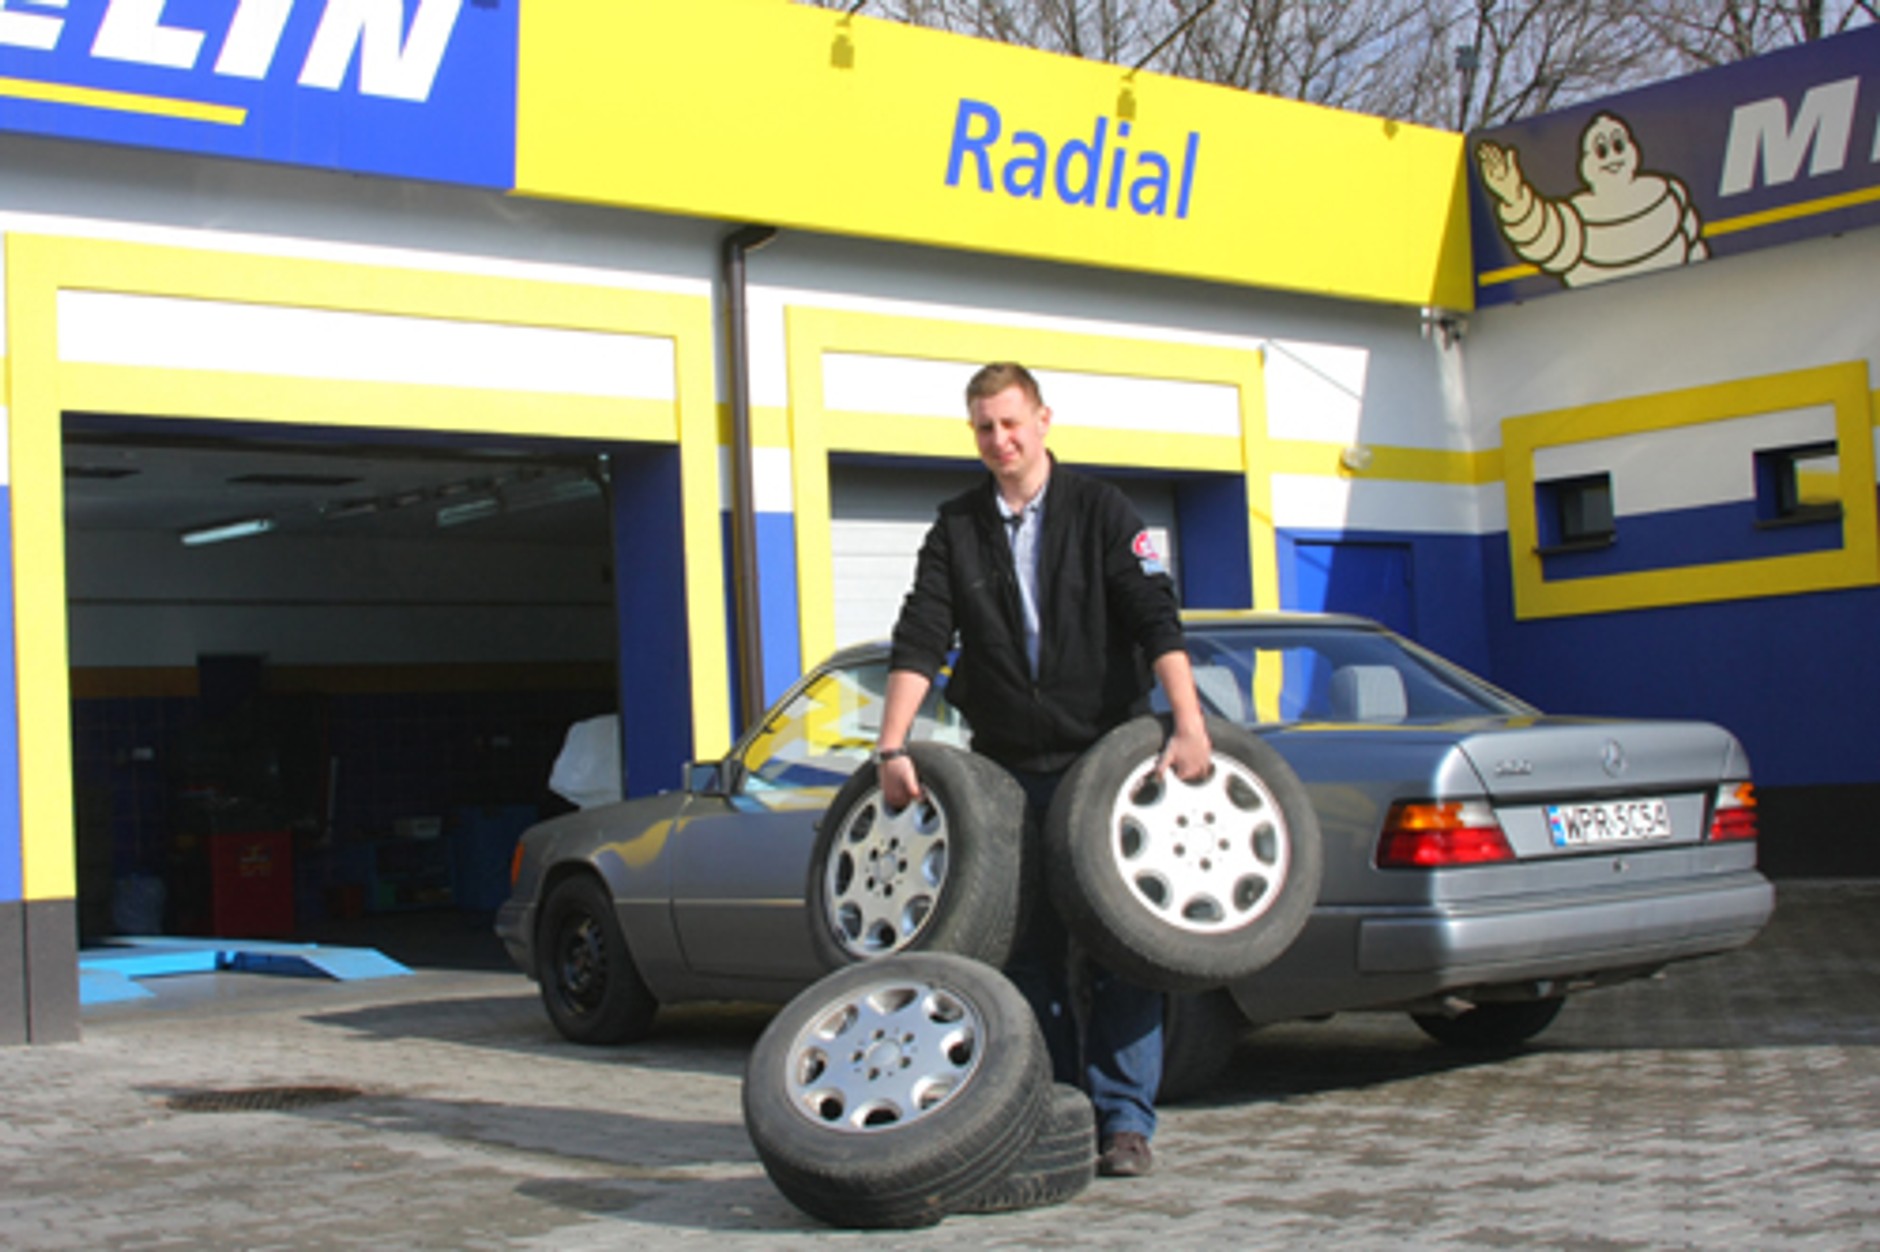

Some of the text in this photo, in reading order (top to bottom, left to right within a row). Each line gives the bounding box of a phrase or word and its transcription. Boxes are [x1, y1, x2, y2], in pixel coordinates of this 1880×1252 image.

[944, 97, 1200, 219] Radial
[1718, 74, 1880, 197] M
[1562, 806, 1612, 840] WPR
